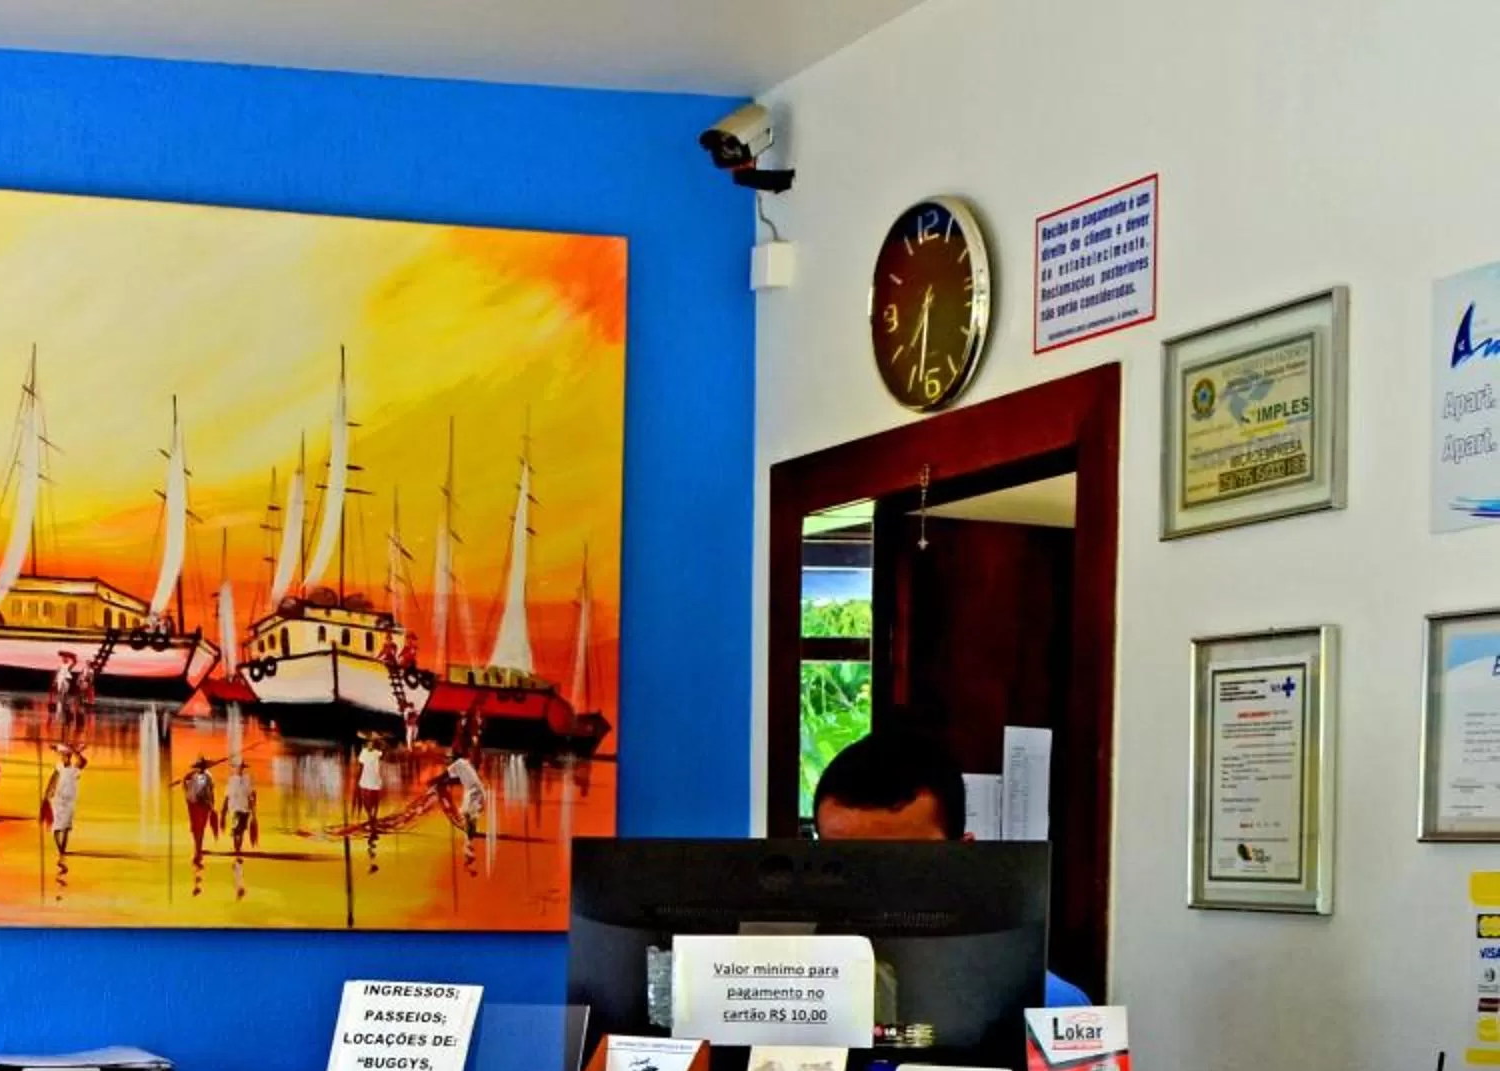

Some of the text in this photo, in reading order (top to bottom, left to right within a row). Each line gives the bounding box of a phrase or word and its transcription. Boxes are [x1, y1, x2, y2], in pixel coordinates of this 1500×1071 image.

[1082, 200, 1127, 228] pagamento
[1136, 192, 1150, 207] um
[917, 209, 940, 245] 12
[1126, 214, 1149, 232] dever
[1041, 256, 1149, 301] Reclamações posteriores
[883, 303, 899, 333] 9
[1057, 300, 1079, 318] serão
[924, 366, 941, 399] 6
[1441, 427, 1498, 465] Apart.
[713, 961, 750, 975] Valor
[808, 965, 839, 978] para
[727, 986, 825, 1000] pagamento no
[364, 1009, 448, 1025] PASSEIOS;
[723, 1007, 828, 1023] cartão R$ 10,00
[1052, 1016, 1104, 1041] Lokar
[343, 1032, 458, 1048] LOCAÇÕES DE:
